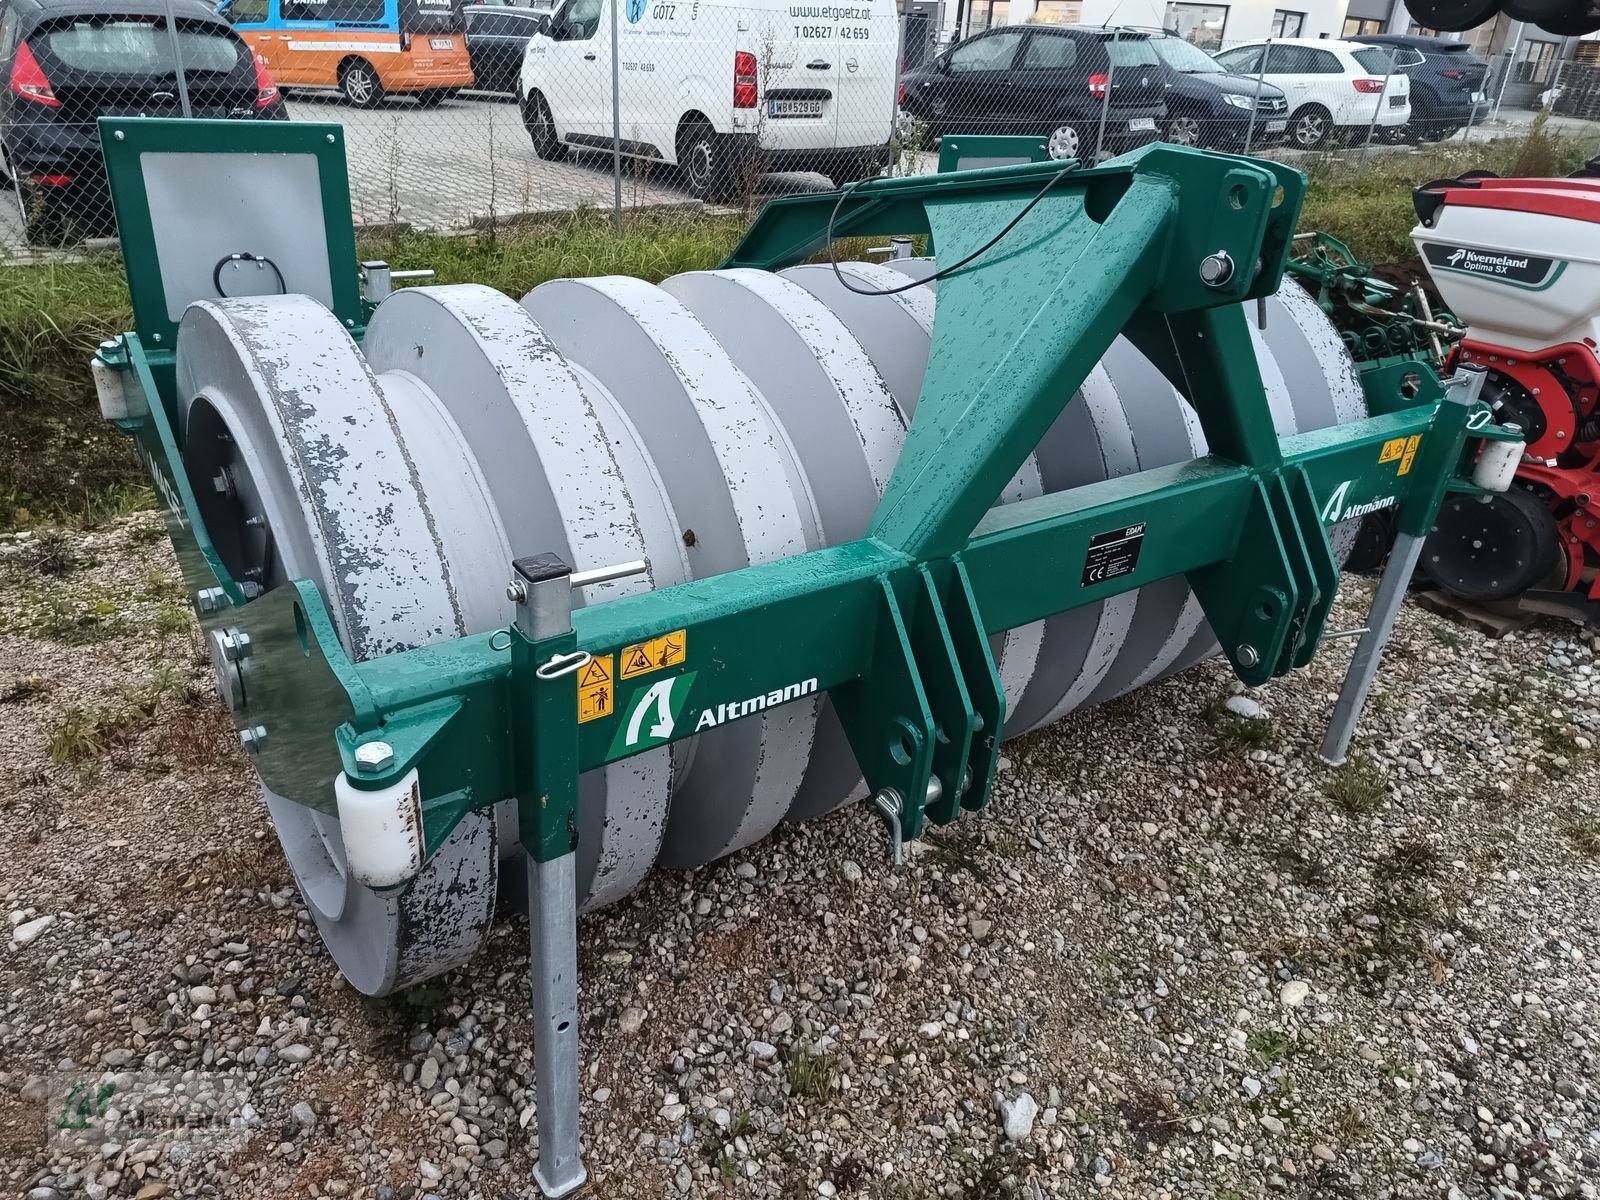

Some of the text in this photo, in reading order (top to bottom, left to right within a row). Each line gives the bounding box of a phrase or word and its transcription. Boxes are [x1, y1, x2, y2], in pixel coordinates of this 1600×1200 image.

[789, 5, 872, 21] www.etgoetz.at
[794, 26, 800, 38] T
[802, 26, 832, 38] 02627
[840, 27, 851, 39] 42
[853, 28, 869, 40] 659
[1464, 261, 1508, 274] Optima SX
[1466, 251, 1528, 268] Kverneland
[1341, 496, 1395, 521] Altmann
[695, 677, 818, 733] Altmann
